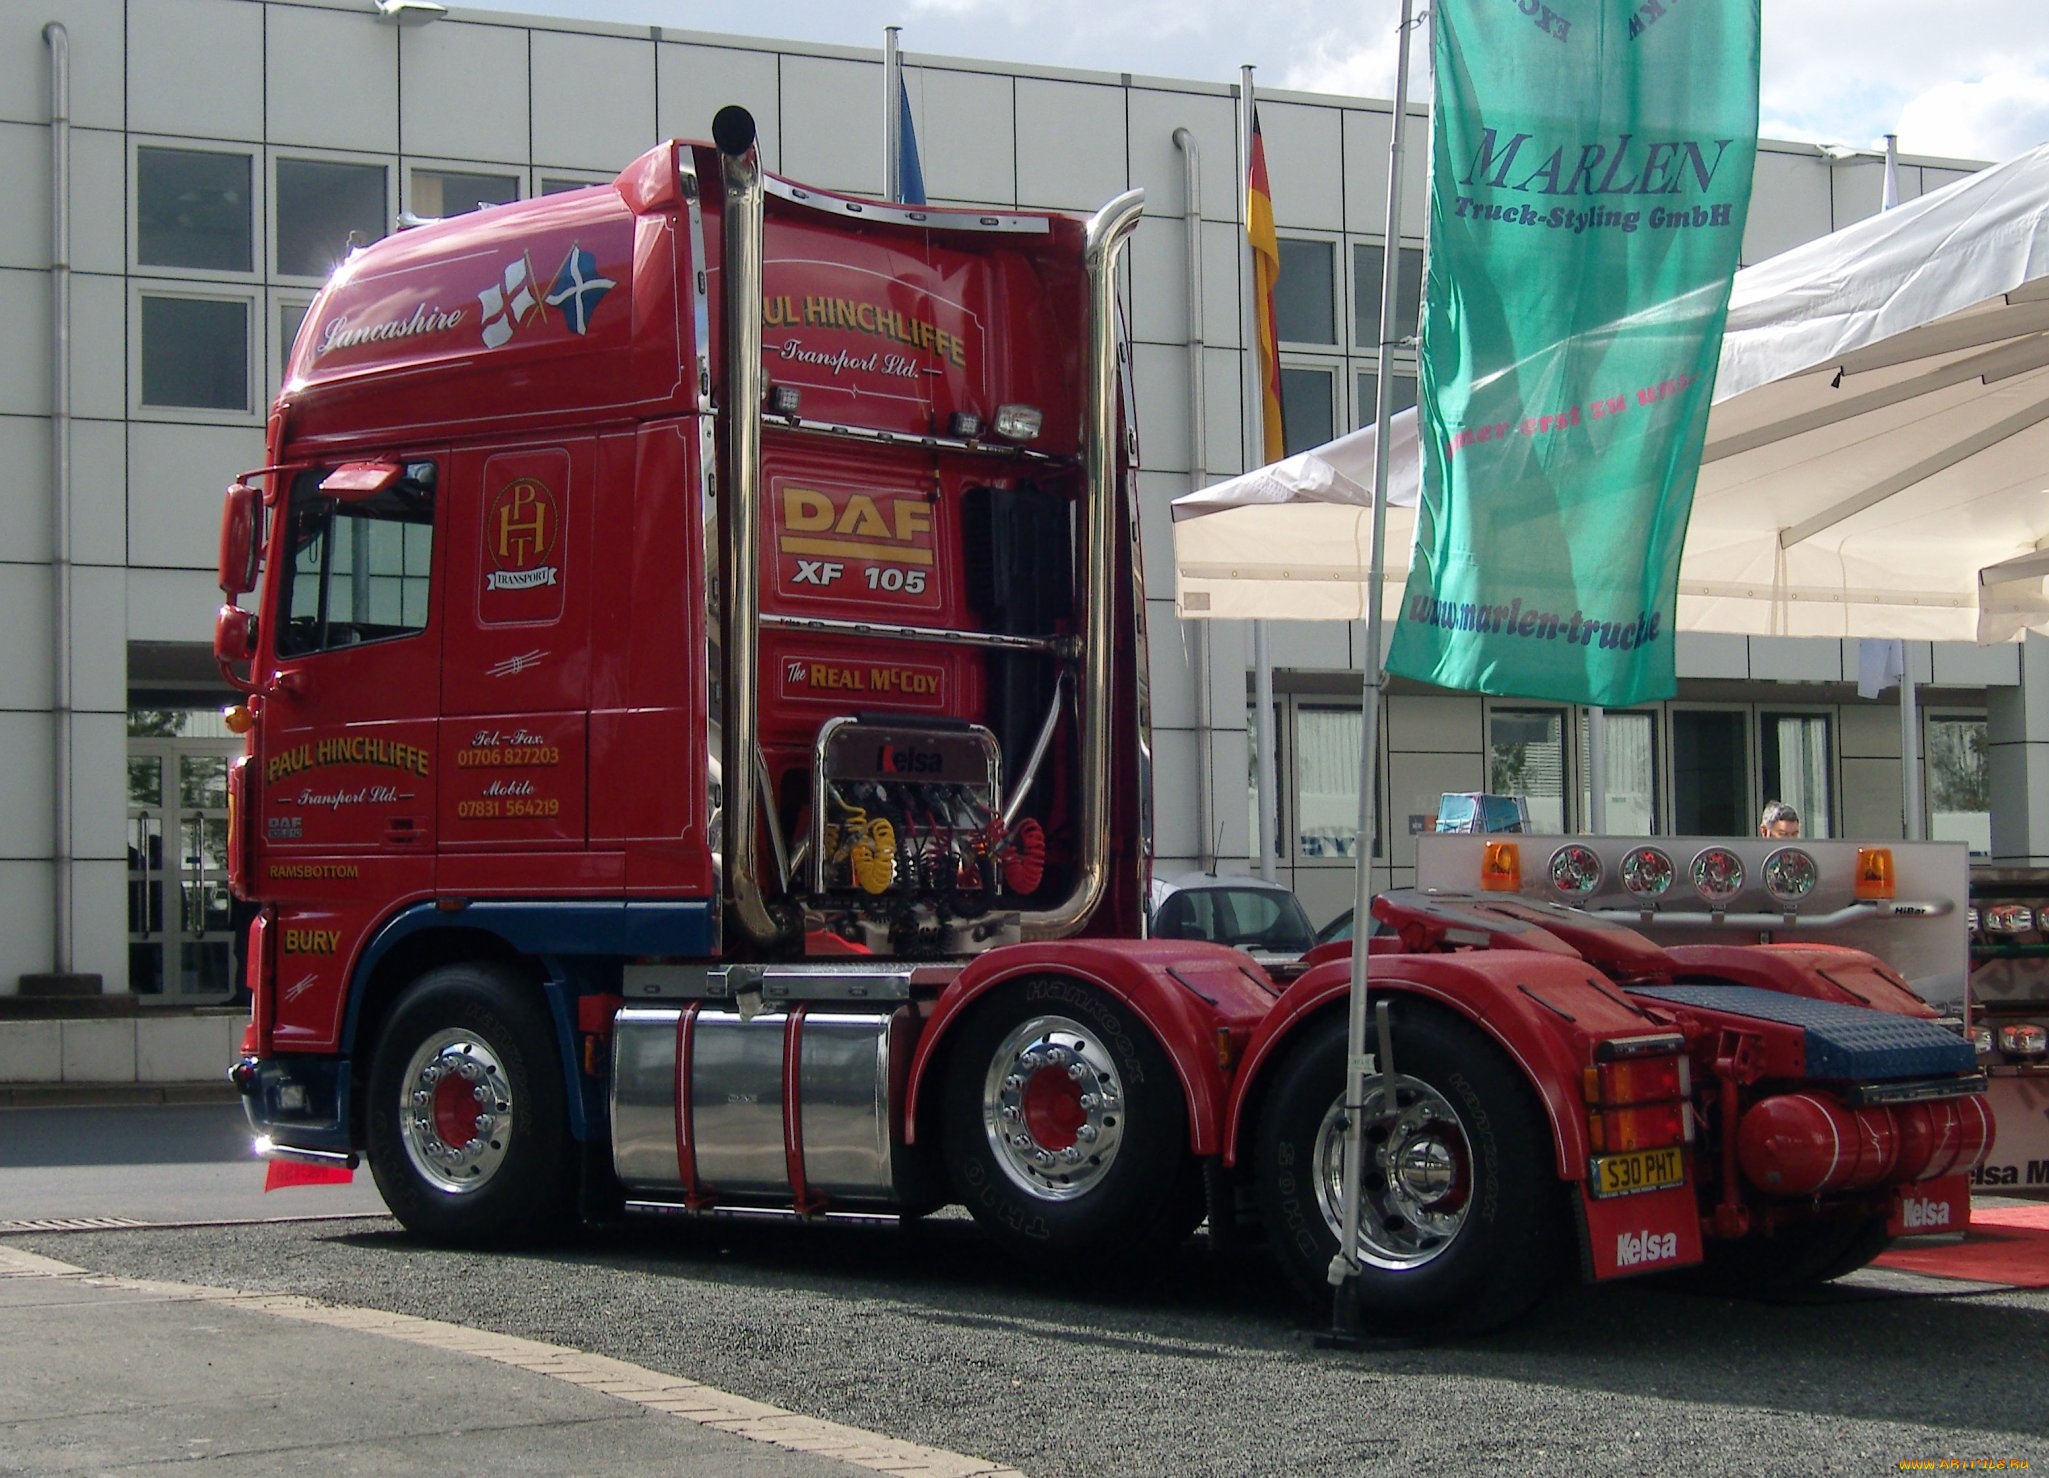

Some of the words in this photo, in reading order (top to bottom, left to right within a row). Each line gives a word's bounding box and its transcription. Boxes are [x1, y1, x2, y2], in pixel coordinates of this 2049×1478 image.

[1459, 127, 1733, 197] MARLEN
[1455, 196, 1640, 234] Truck-Styling
[1649, 203, 1733, 229] GmbH
[317, 302, 469, 352] Lancashire
[762, 296, 800, 328] UL
[804, 296, 966, 368] HINCHLIFFE
[780, 338, 878, 376] Transport
[881, 353, 919, 378] Ltd.
[1521, 405, 1581, 436] erst
[1591, 394, 1626, 421] zu
[782, 486, 932, 542] DAF
[498, 570, 547, 585] TRANSPORT
[791, 559, 844, 586] XF
[864, 566, 927, 595] 105
[787, 661, 806, 683] The
[810, 663, 866, 691] REAL
[266, 743, 314, 785] PAUL
[316, 736, 430, 777] HINCHLIFFE
[458, 749, 501, 766] 01706
[504, 747, 559, 764] 827203
[877, 744, 944, 773] Kelsa
[298, 788, 366, 811] Transport
[369, 785, 398, 803] Ltd.
[483, 780, 534, 796] Mobile
[268, 817, 303, 829] DAF
[458, 801, 500, 817] 07831
[506, 799, 560, 816] 564219
[269, 865, 359, 879] RAMSBOTTOM
[285, 930, 342, 954] BURY
[1607, 1156, 1642, 1188] S30
[1645, 1151, 1676, 1184] PHT
[1902, 1197, 1950, 1228] Kelsa
[1616, 1229, 1677, 1267] Kelsa
